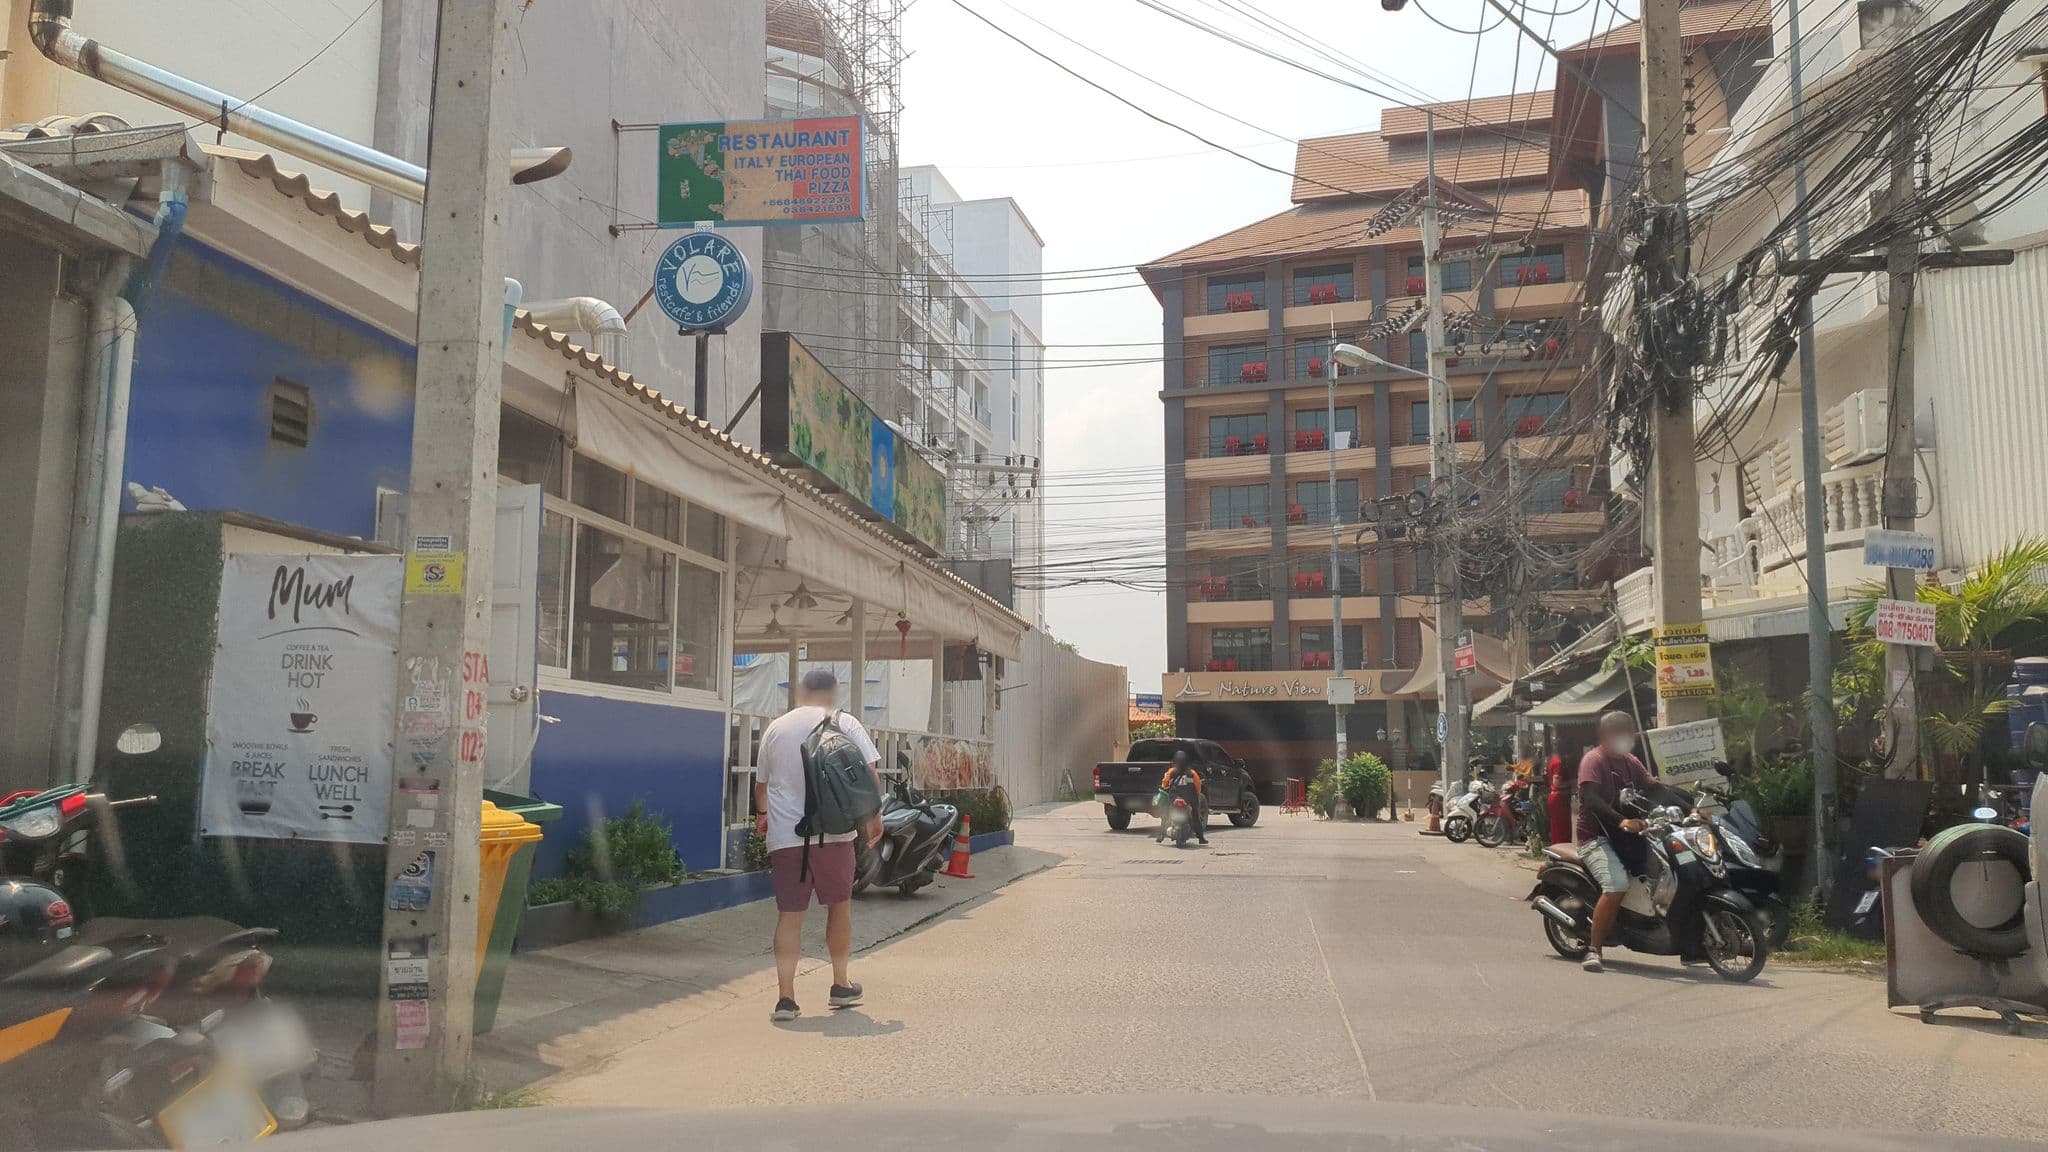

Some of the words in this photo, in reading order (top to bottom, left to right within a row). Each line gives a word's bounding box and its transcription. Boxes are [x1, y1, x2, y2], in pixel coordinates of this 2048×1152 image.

[718, 130, 850, 152] RESTAURANT
[734, 156, 774, 168] ITALY
[780, 153, 850, 167] EUROPEAN
[775, 169, 806, 182] THAI
[812, 167, 850, 180] FOOD
[808, 182, 850, 194] PIZZA
[662, 238, 741, 277] VOLARE
[707, 282, 740, 320] friends
[268, 565, 354, 624] Mum
[282, 654, 334, 670] DRINK
[463, 651, 489, 683] STA
[288, 672, 325, 688] HOT
[1218, 680, 1277, 697] Nature
[1282, 680, 1321, 696] View
[309, 766, 368, 783] LUNCH
[316, 784, 362, 802] WELL
